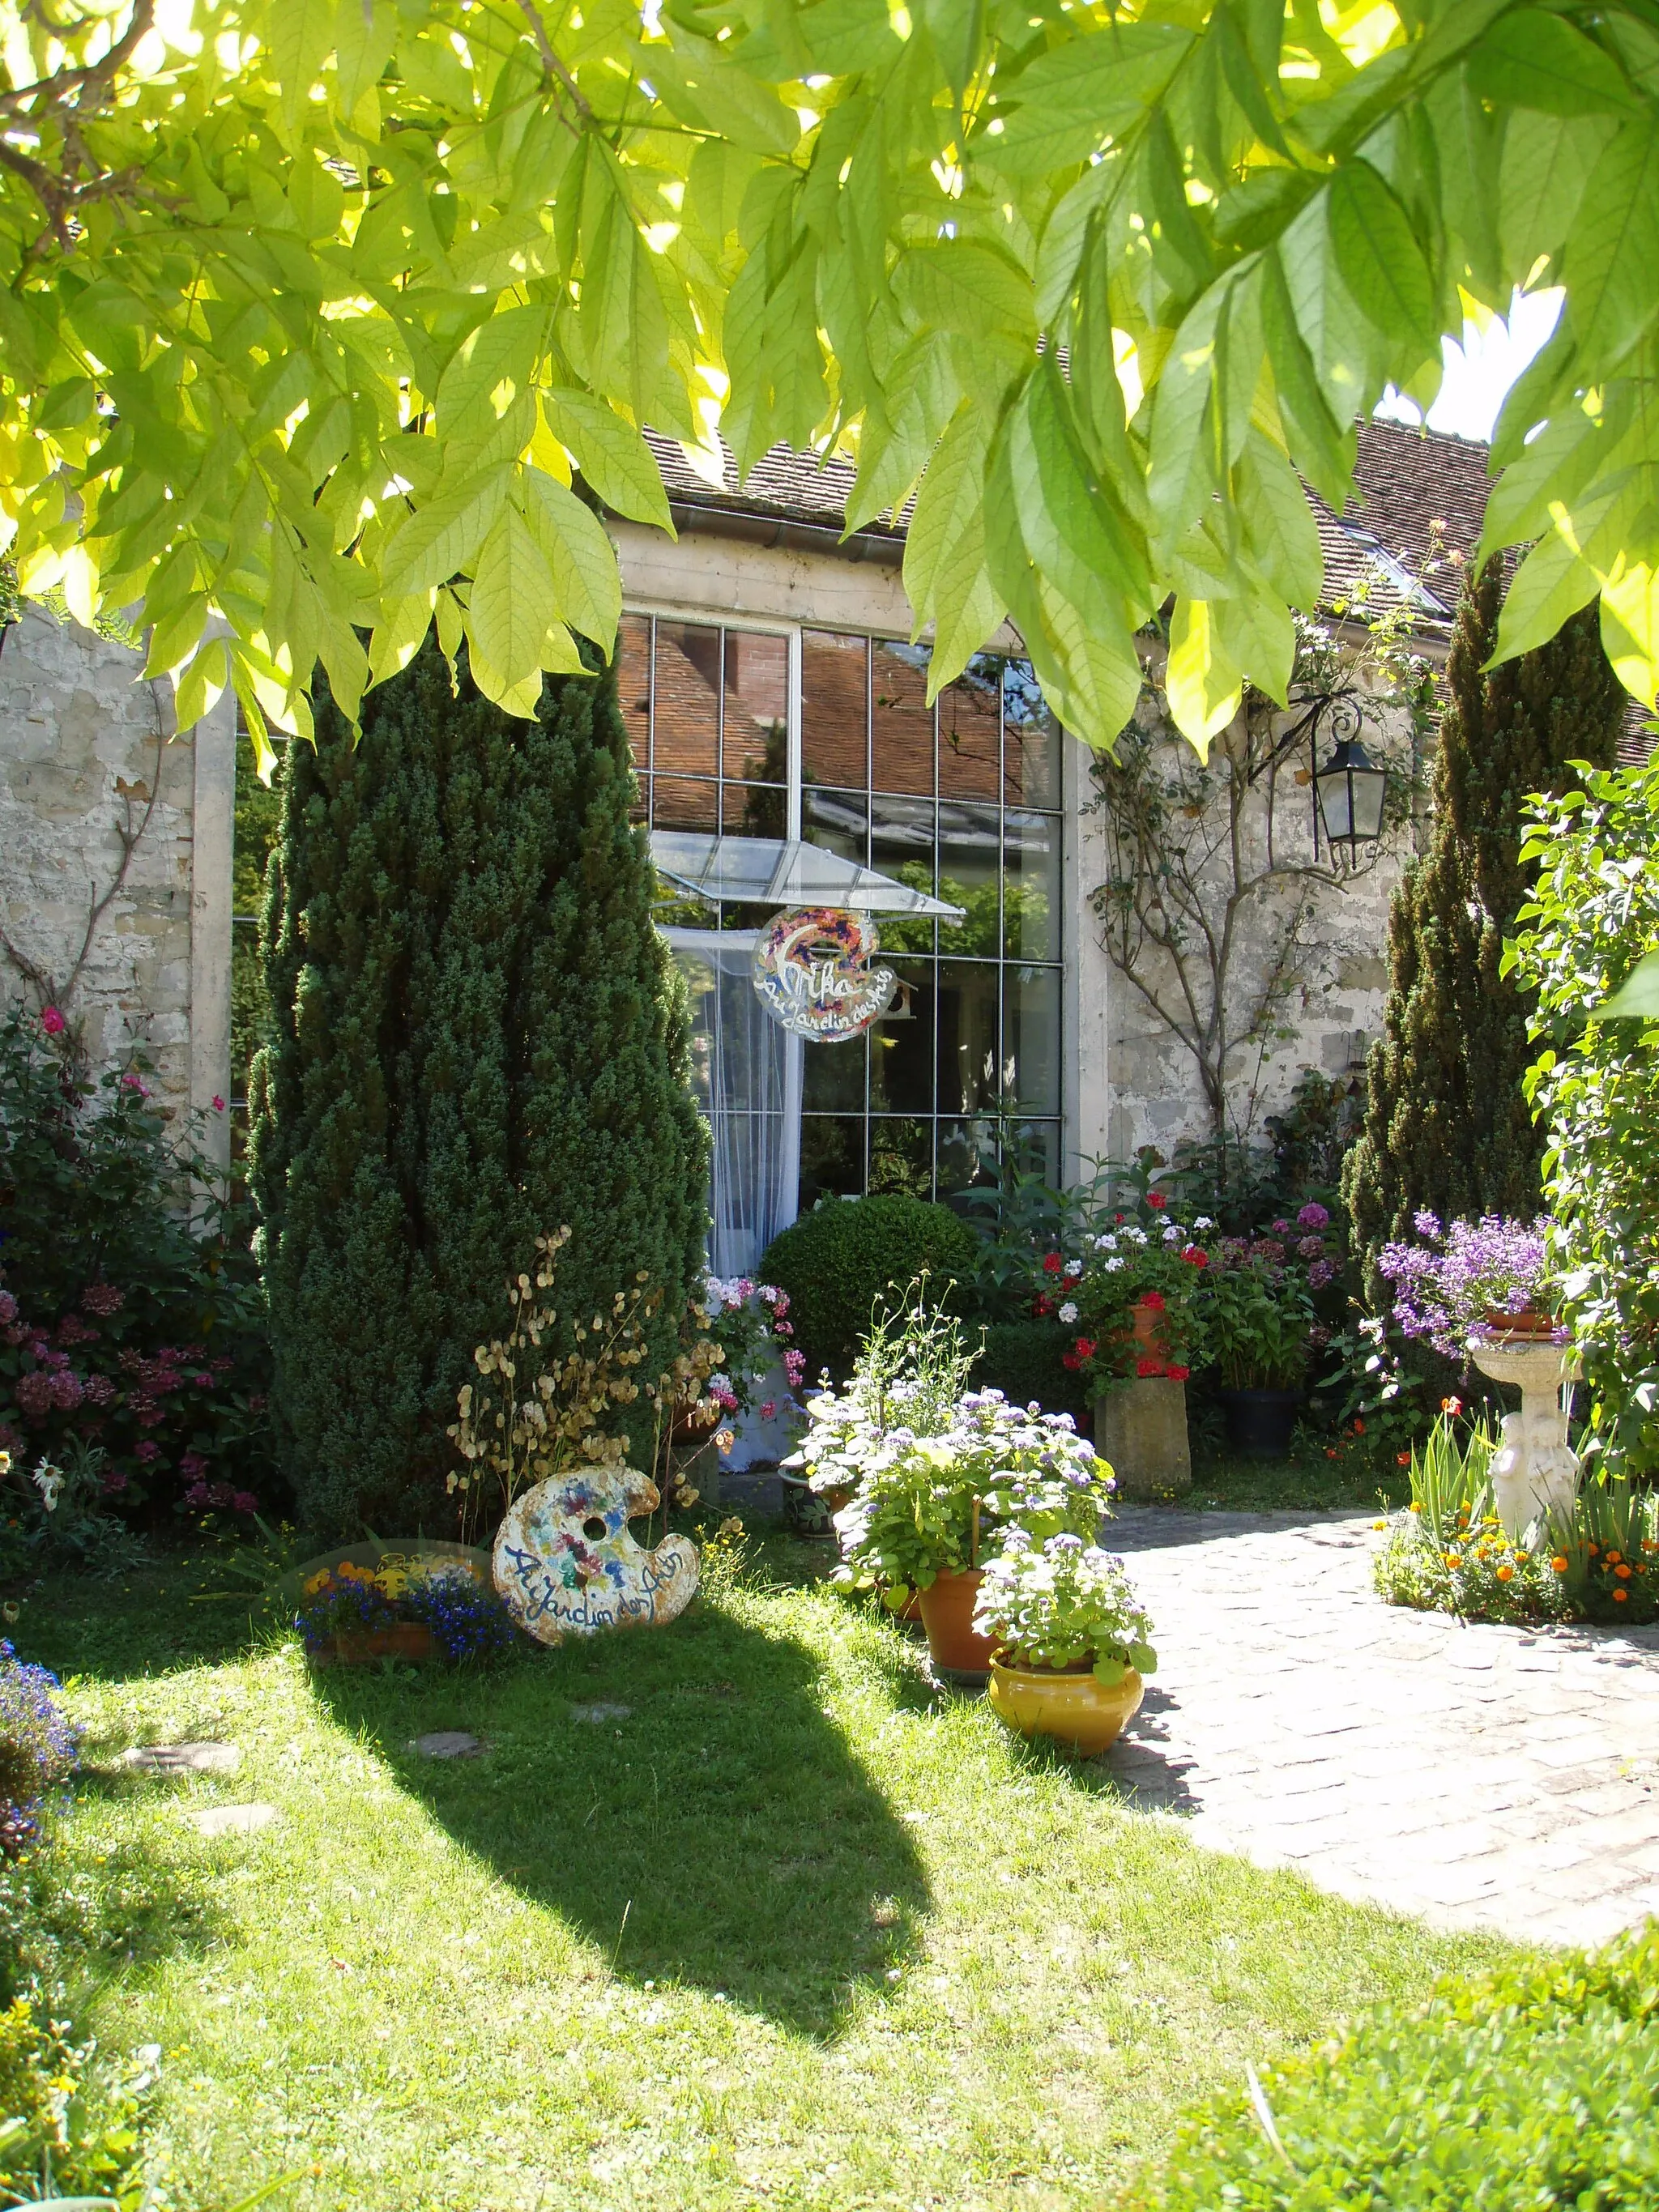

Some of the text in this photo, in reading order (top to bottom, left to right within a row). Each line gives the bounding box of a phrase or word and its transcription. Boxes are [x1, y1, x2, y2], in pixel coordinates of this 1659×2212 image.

[781, 1001, 855, 1030] Jardin
[526, 1575, 616, 1627] Jardin
[616, 1592, 650, 1621] des
[638, 1551, 683, 1625] Arts
